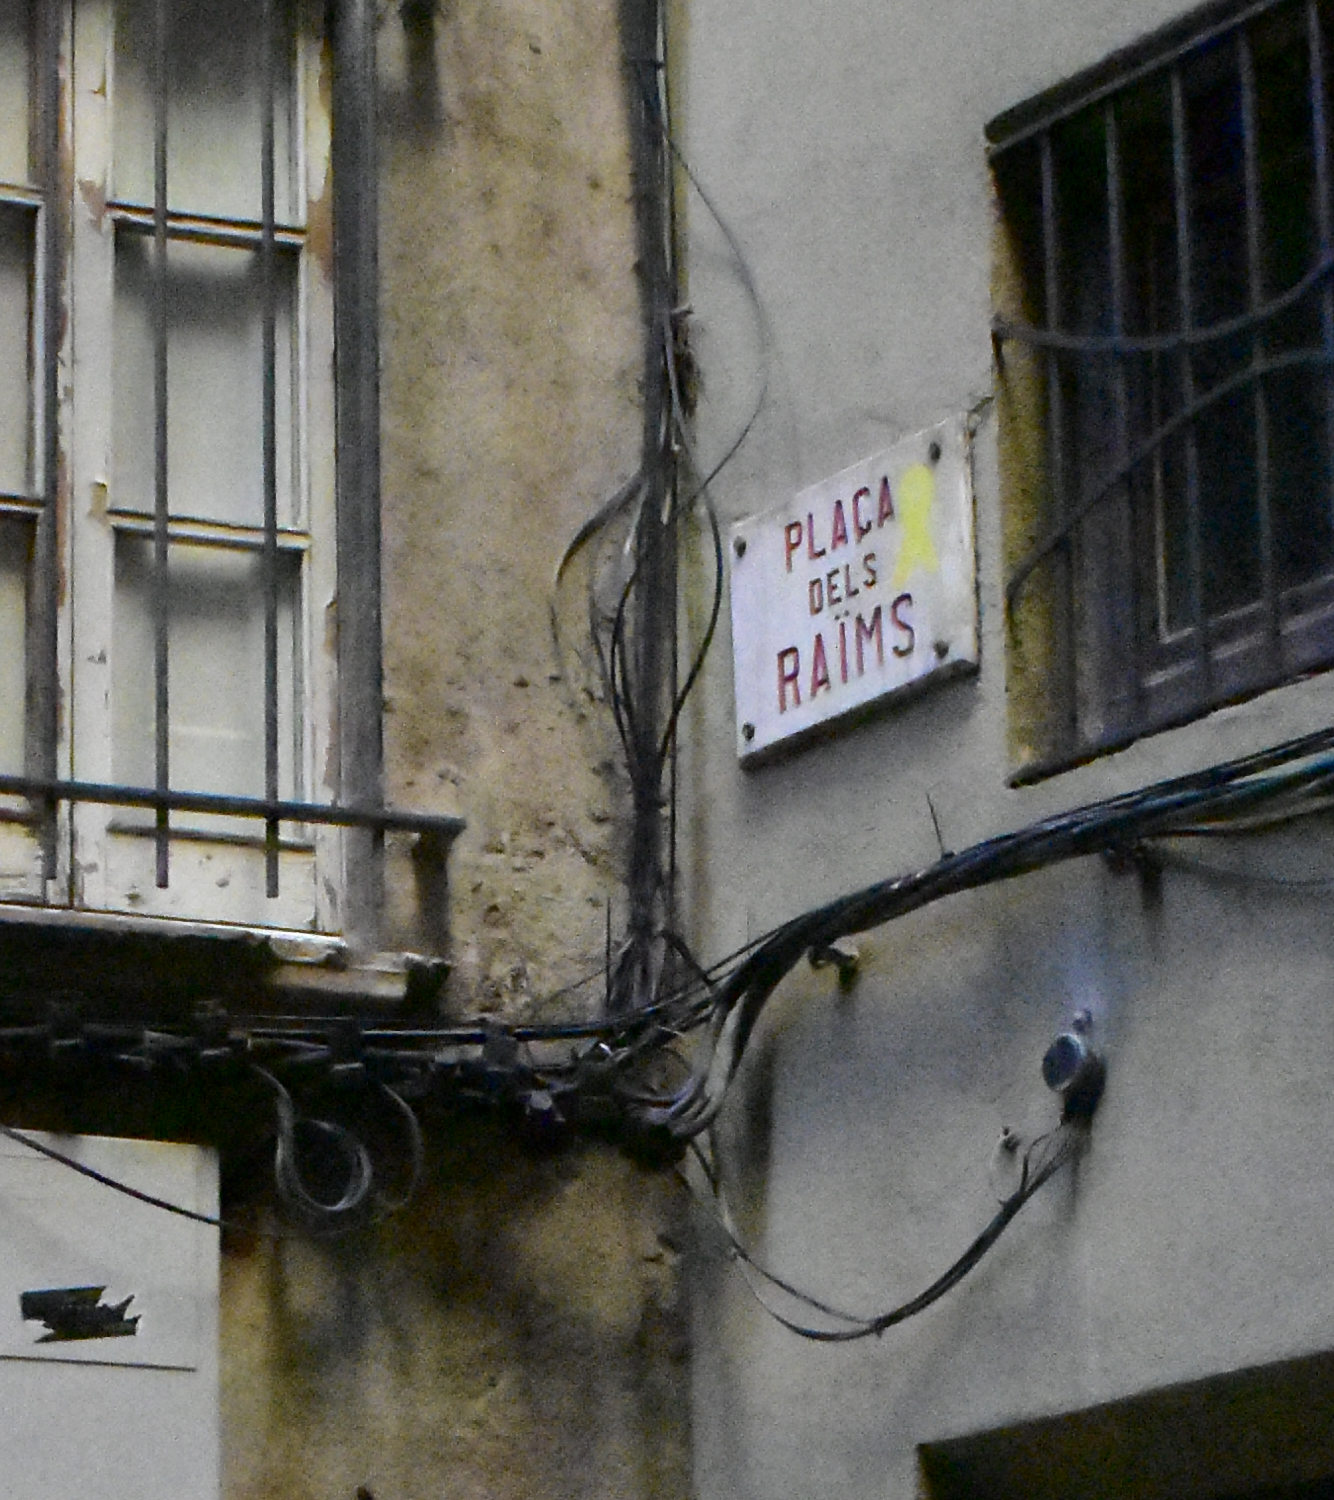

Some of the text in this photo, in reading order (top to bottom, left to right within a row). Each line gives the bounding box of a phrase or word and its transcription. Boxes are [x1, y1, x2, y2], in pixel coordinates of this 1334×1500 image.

[784, 475, 895, 573] PLAÇA
[808, 552, 878, 617] DELS
[777, 592, 916, 714] RAÏMS
